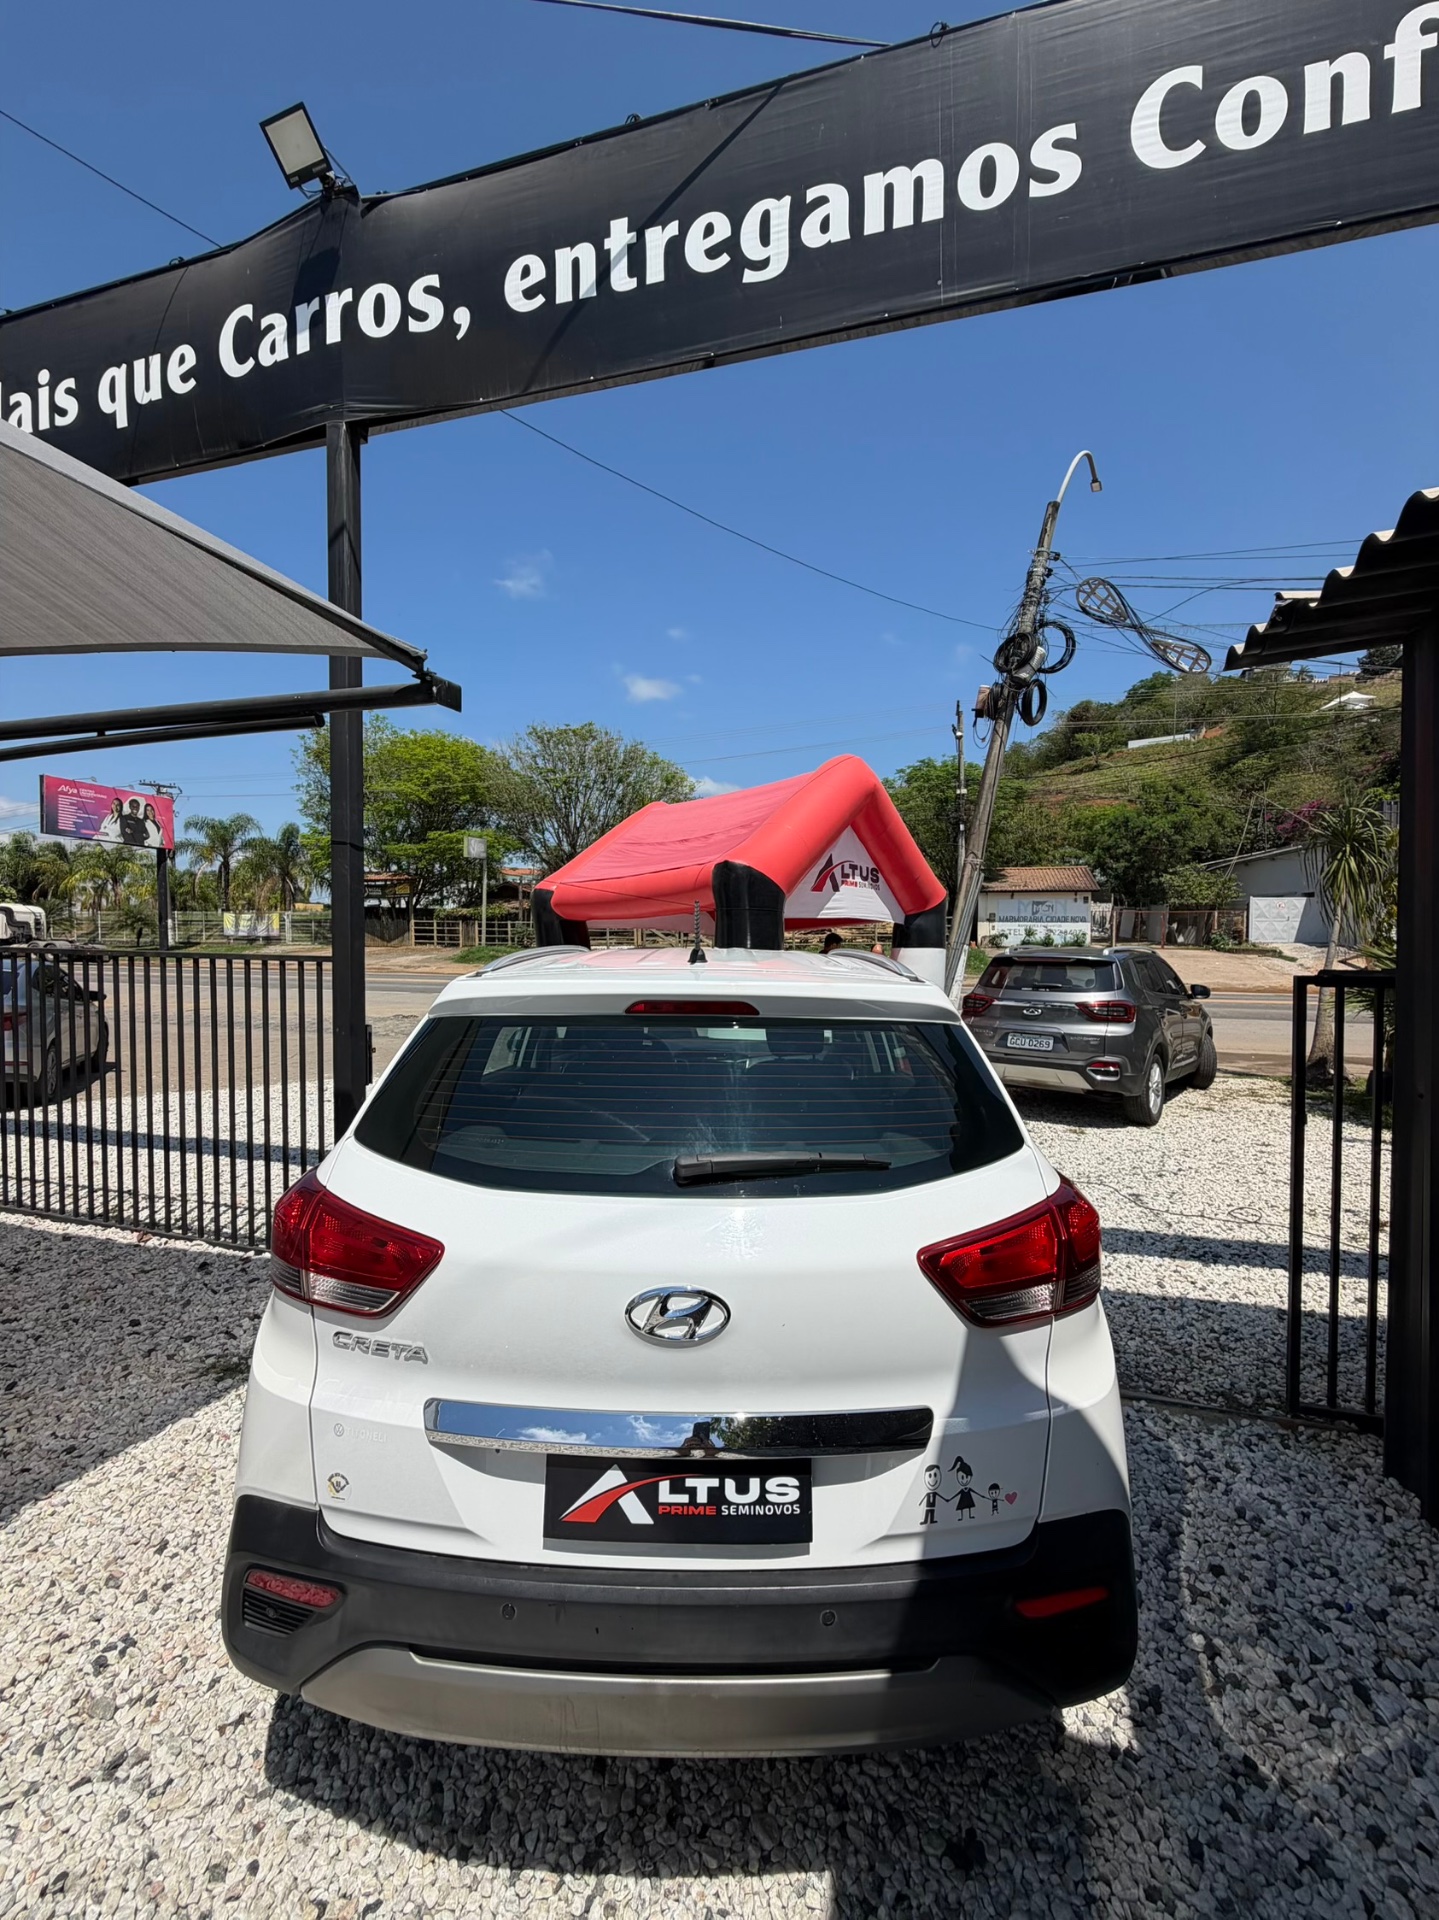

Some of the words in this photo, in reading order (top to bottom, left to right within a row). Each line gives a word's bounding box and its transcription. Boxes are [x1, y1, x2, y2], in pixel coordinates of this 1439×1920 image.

[0, 368, 79, 433] ais
[97, 344, 197, 429] que
[218, 273, 471, 378] Carros,
[504, 122, 1083, 313] entregamos
[1130, 0, 1439, 170] Conf
[57, 785, 78, 794] Afya
[811, 853, 880, 892] ALTUS
[1009, 1037, 1026, 1047] GCU
[1028, 1038, 1051, 1049] 0269
[332, 1331, 429, 1365] CRETA
[559, 1464, 801, 1525] ALTUS
[658, 1505, 717, 1516] PRIME
[721, 1503, 801, 1516] SEMINOVOS
